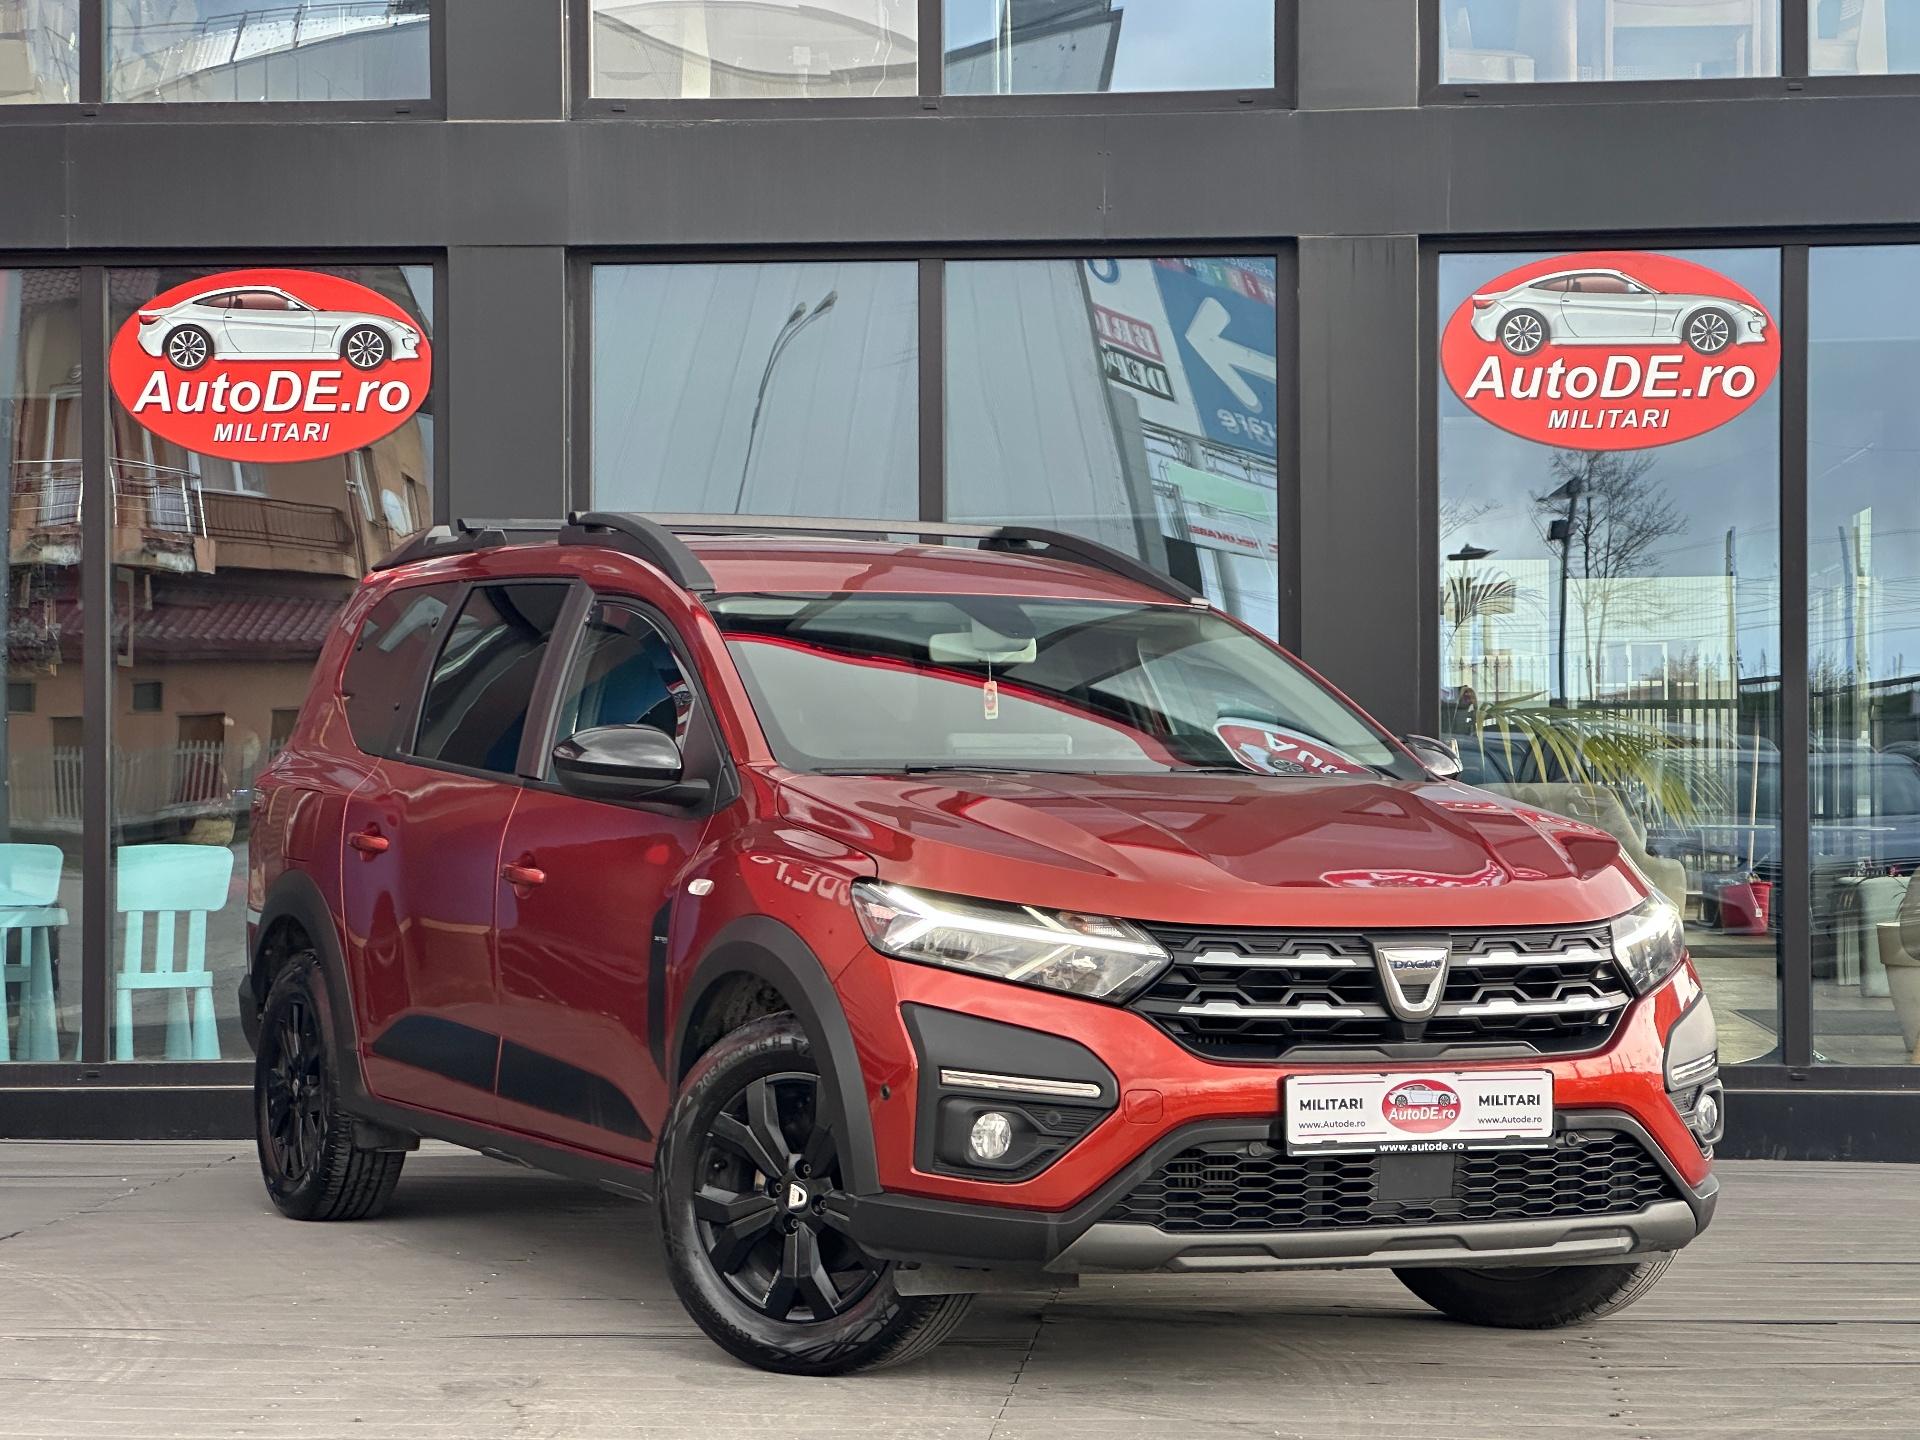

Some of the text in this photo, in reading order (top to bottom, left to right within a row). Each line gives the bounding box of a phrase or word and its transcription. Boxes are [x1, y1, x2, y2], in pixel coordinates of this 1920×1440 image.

[1465, 354, 1757, 399] AutoDE.ro
[133, 369, 412, 414] AutoDE.ro
[1547, 408, 1671, 430] MILITARI
[212, 422, 331, 443] MILITARI
[1394, 959, 1440, 969] DACIA
[1299, 1098, 1364, 1111] MILITARI
[1478, 1094, 1541, 1107] MILITARI
[1388, 1106, 1456, 1121] AutoDE.ro
[1478, 1115, 1543, 1125] www.Autode.ro
[1298, 1119, 1366, 1129] www.Autode.ro
[1379, 1141, 1465, 1152] www.autode.ro
